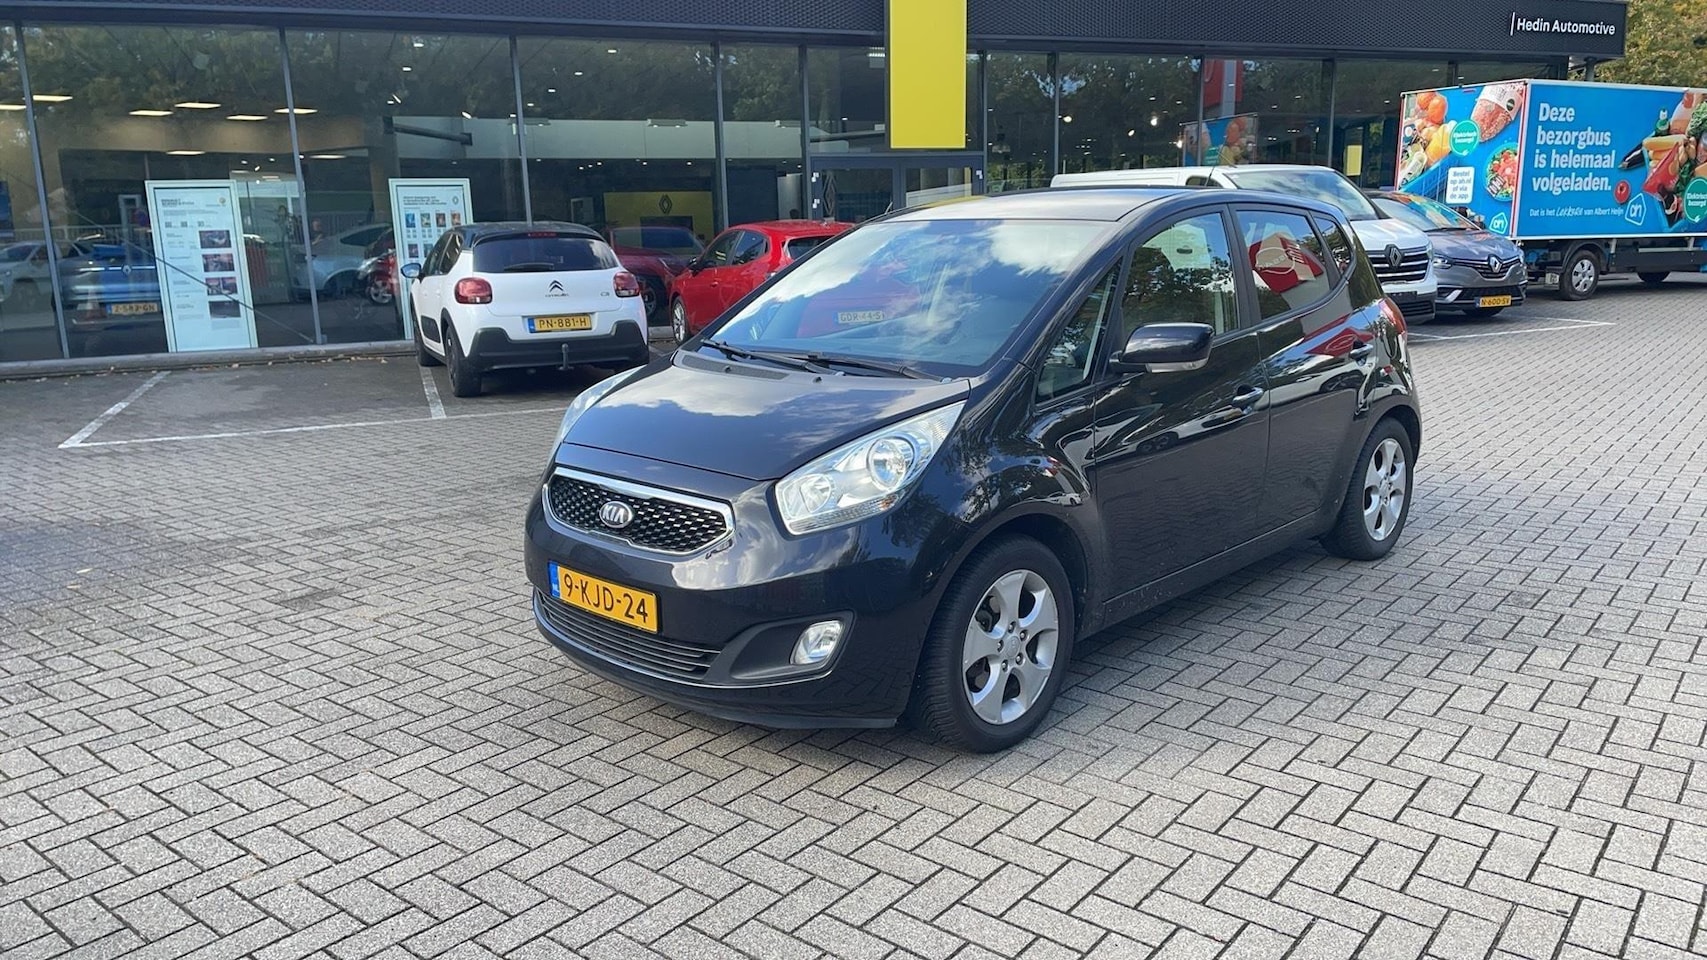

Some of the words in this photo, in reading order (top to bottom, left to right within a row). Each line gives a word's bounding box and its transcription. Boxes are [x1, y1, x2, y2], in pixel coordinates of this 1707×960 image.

[1516, 18, 1550, 32] Hedin
[1551, 19, 1616, 35] Automotive
[1538, 103, 1575, 122] Deze
[1536, 125, 1611, 149] bezorgbus
[1534, 149, 1547, 168] is
[1550, 149, 1616, 168] helemaal
[1532, 172, 1612, 195] volgeladen.
[1529, 208, 1539, 217] Dat
[1540, 208, 1545, 216] is
[1546, 208, 1555, 216] het
[1594, 207, 1610, 215] Albert
[1611, 207, 1624, 216] Heijn
[539, 317, 587, 329] PN-881-H
[602, 504, 625, 523] KIA
[564, 573, 648, 623] 9-KJD-24
